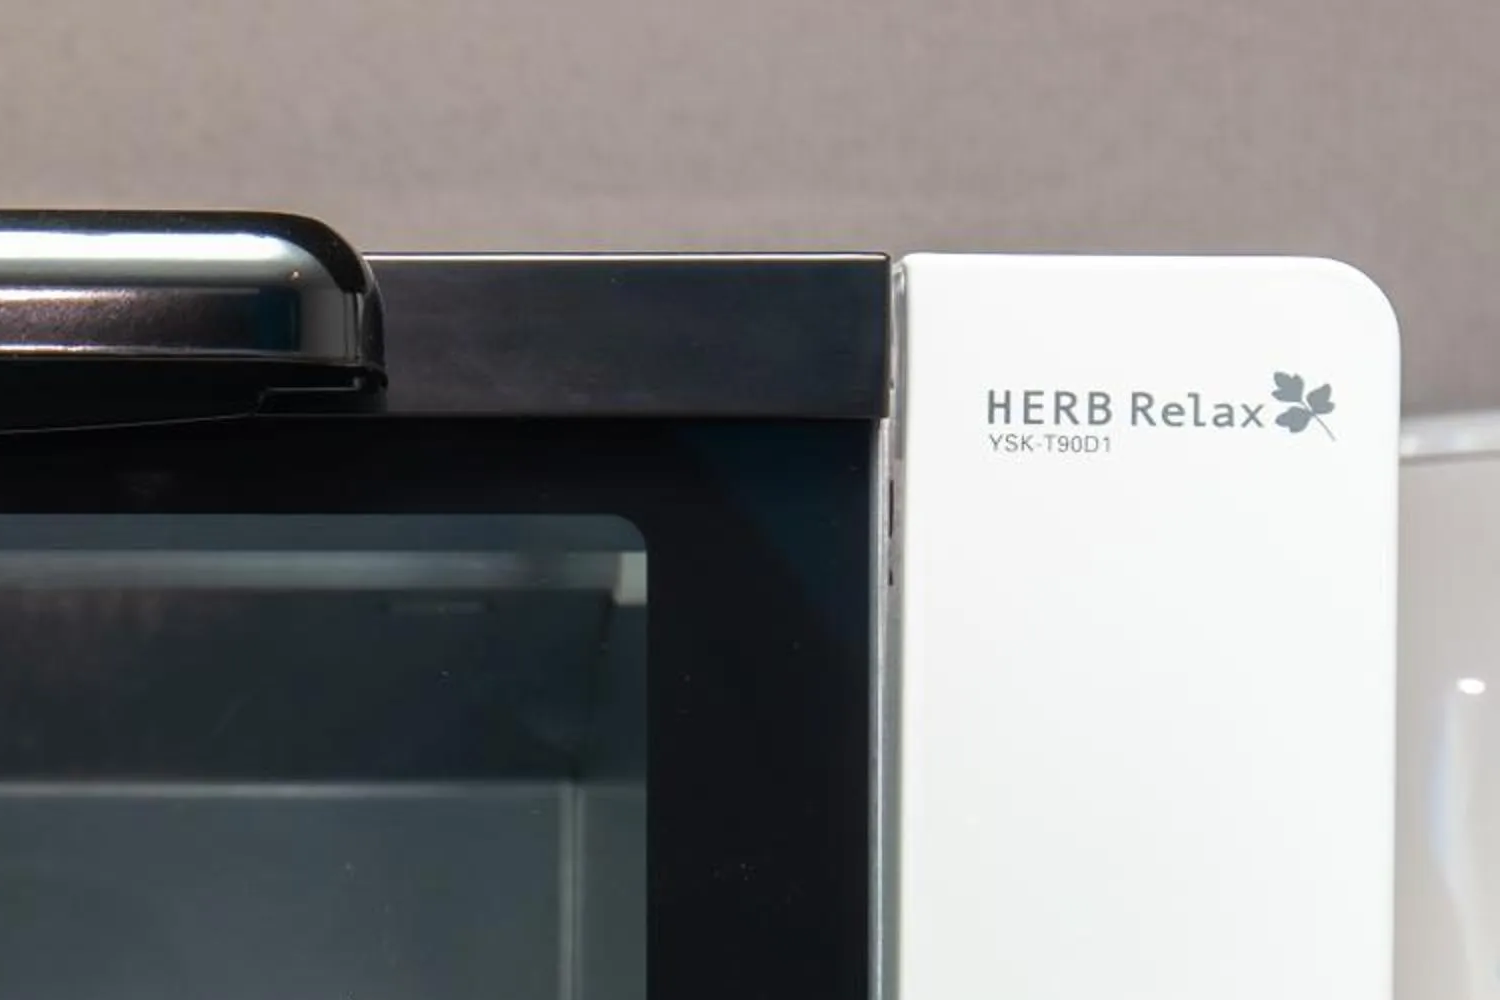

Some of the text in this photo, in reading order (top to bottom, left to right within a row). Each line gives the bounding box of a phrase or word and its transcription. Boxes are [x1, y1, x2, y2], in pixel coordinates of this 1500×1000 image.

[987, 388, 1265, 429] HERB Relax
[988, 433, 1112, 454] YSK-T90D1
